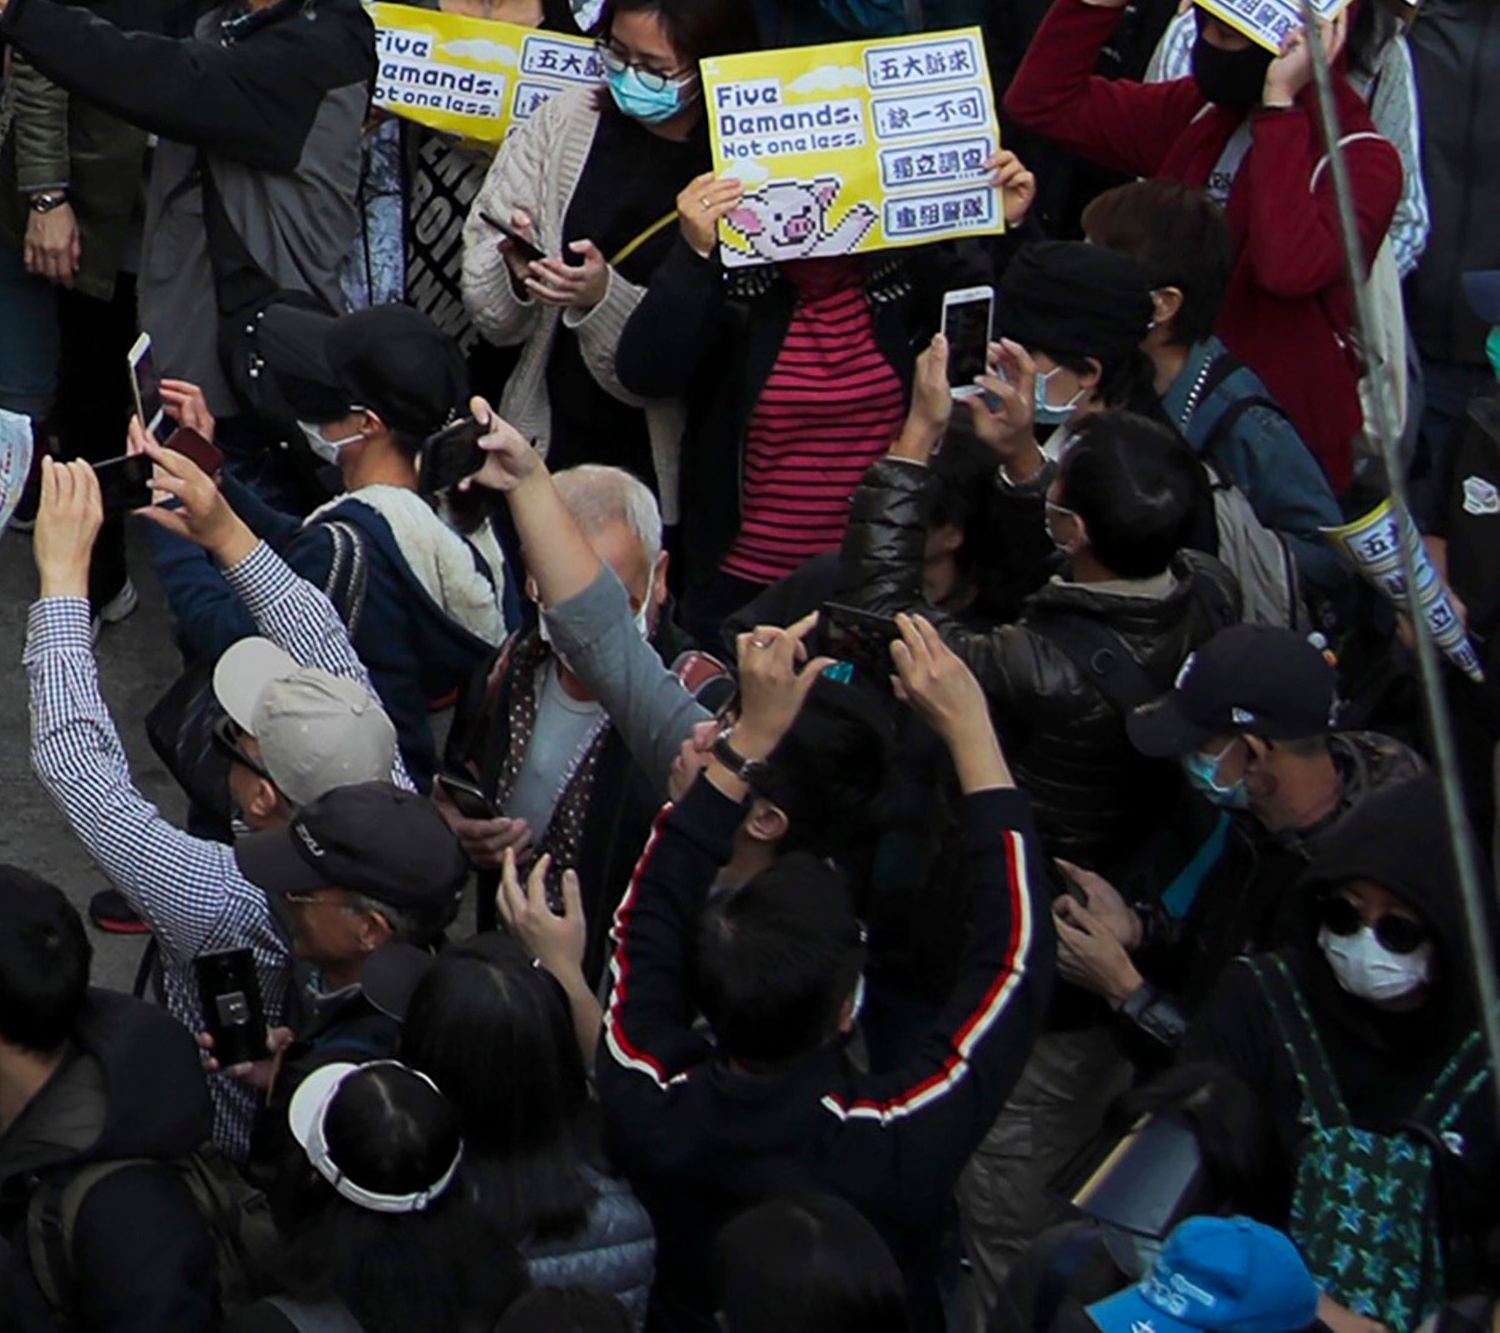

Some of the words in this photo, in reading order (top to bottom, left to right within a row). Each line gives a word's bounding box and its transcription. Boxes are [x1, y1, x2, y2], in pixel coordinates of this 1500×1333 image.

[373, 85, 398, 102] ot
[406, 89, 441, 107] one
[716, 85, 778, 107] Five
[722, 139, 762, 159] Not
[768, 136, 807, 154] one
[809, 130, 863, 151] less.
